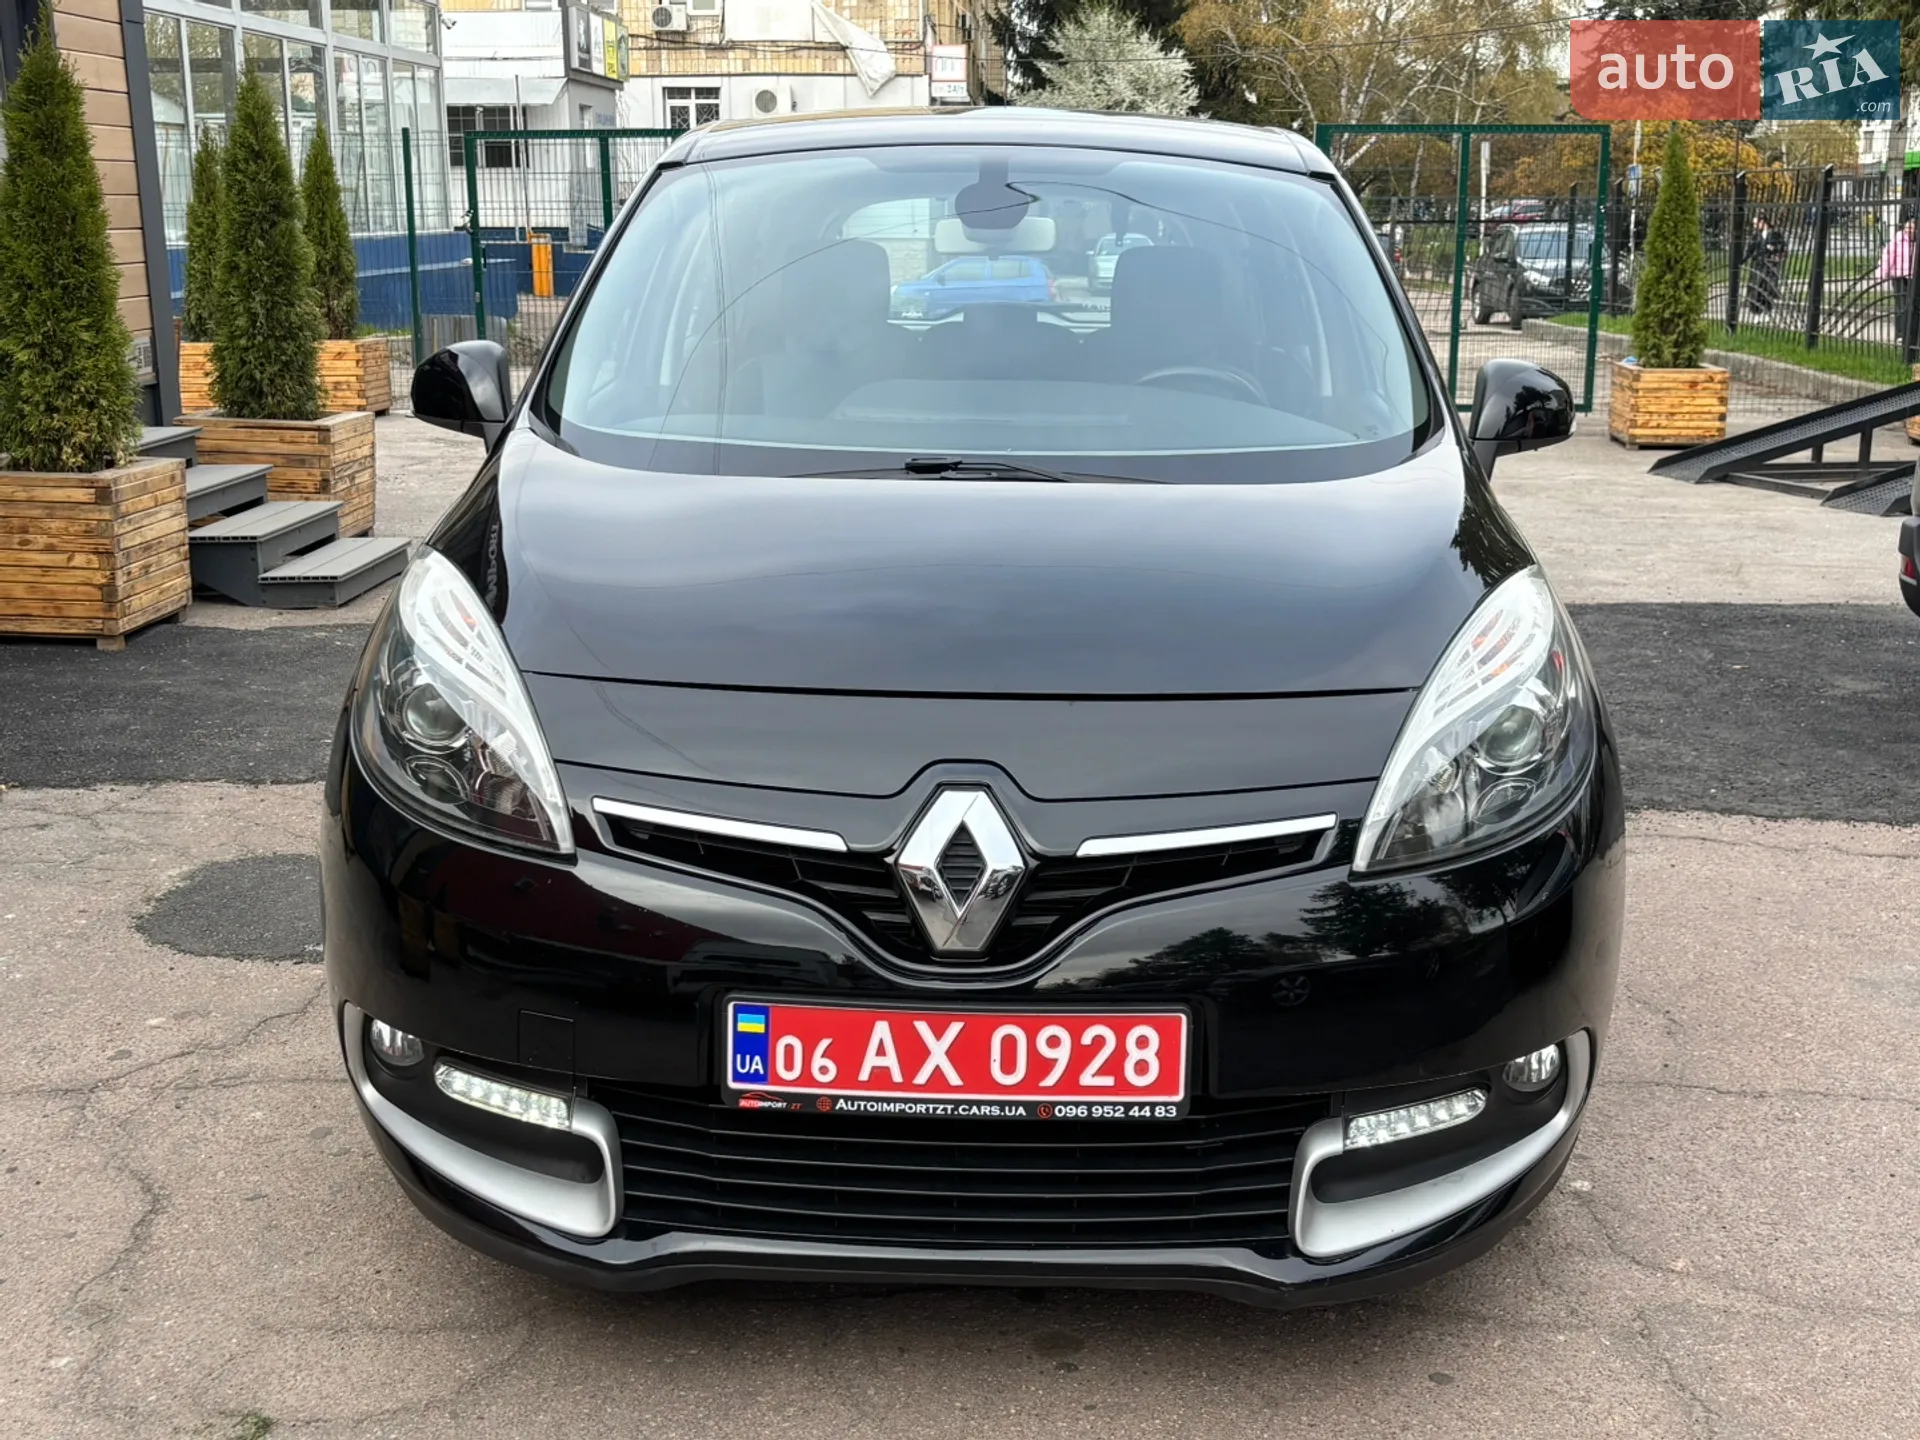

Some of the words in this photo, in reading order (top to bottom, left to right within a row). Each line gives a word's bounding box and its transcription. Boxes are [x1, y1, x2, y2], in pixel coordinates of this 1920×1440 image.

[736, 1053, 765, 1075] UA
[775, 1034, 838, 1083] 06
[857, 1020, 965, 1087] AX
[989, 1024, 1161, 1087] 0928
[1054, 1105, 1088, 1118] 096
[1091, 1105, 1125, 1118] 952
[1128, 1105, 1150, 1118] 44
[1154, 1105, 1177, 1118] 83
